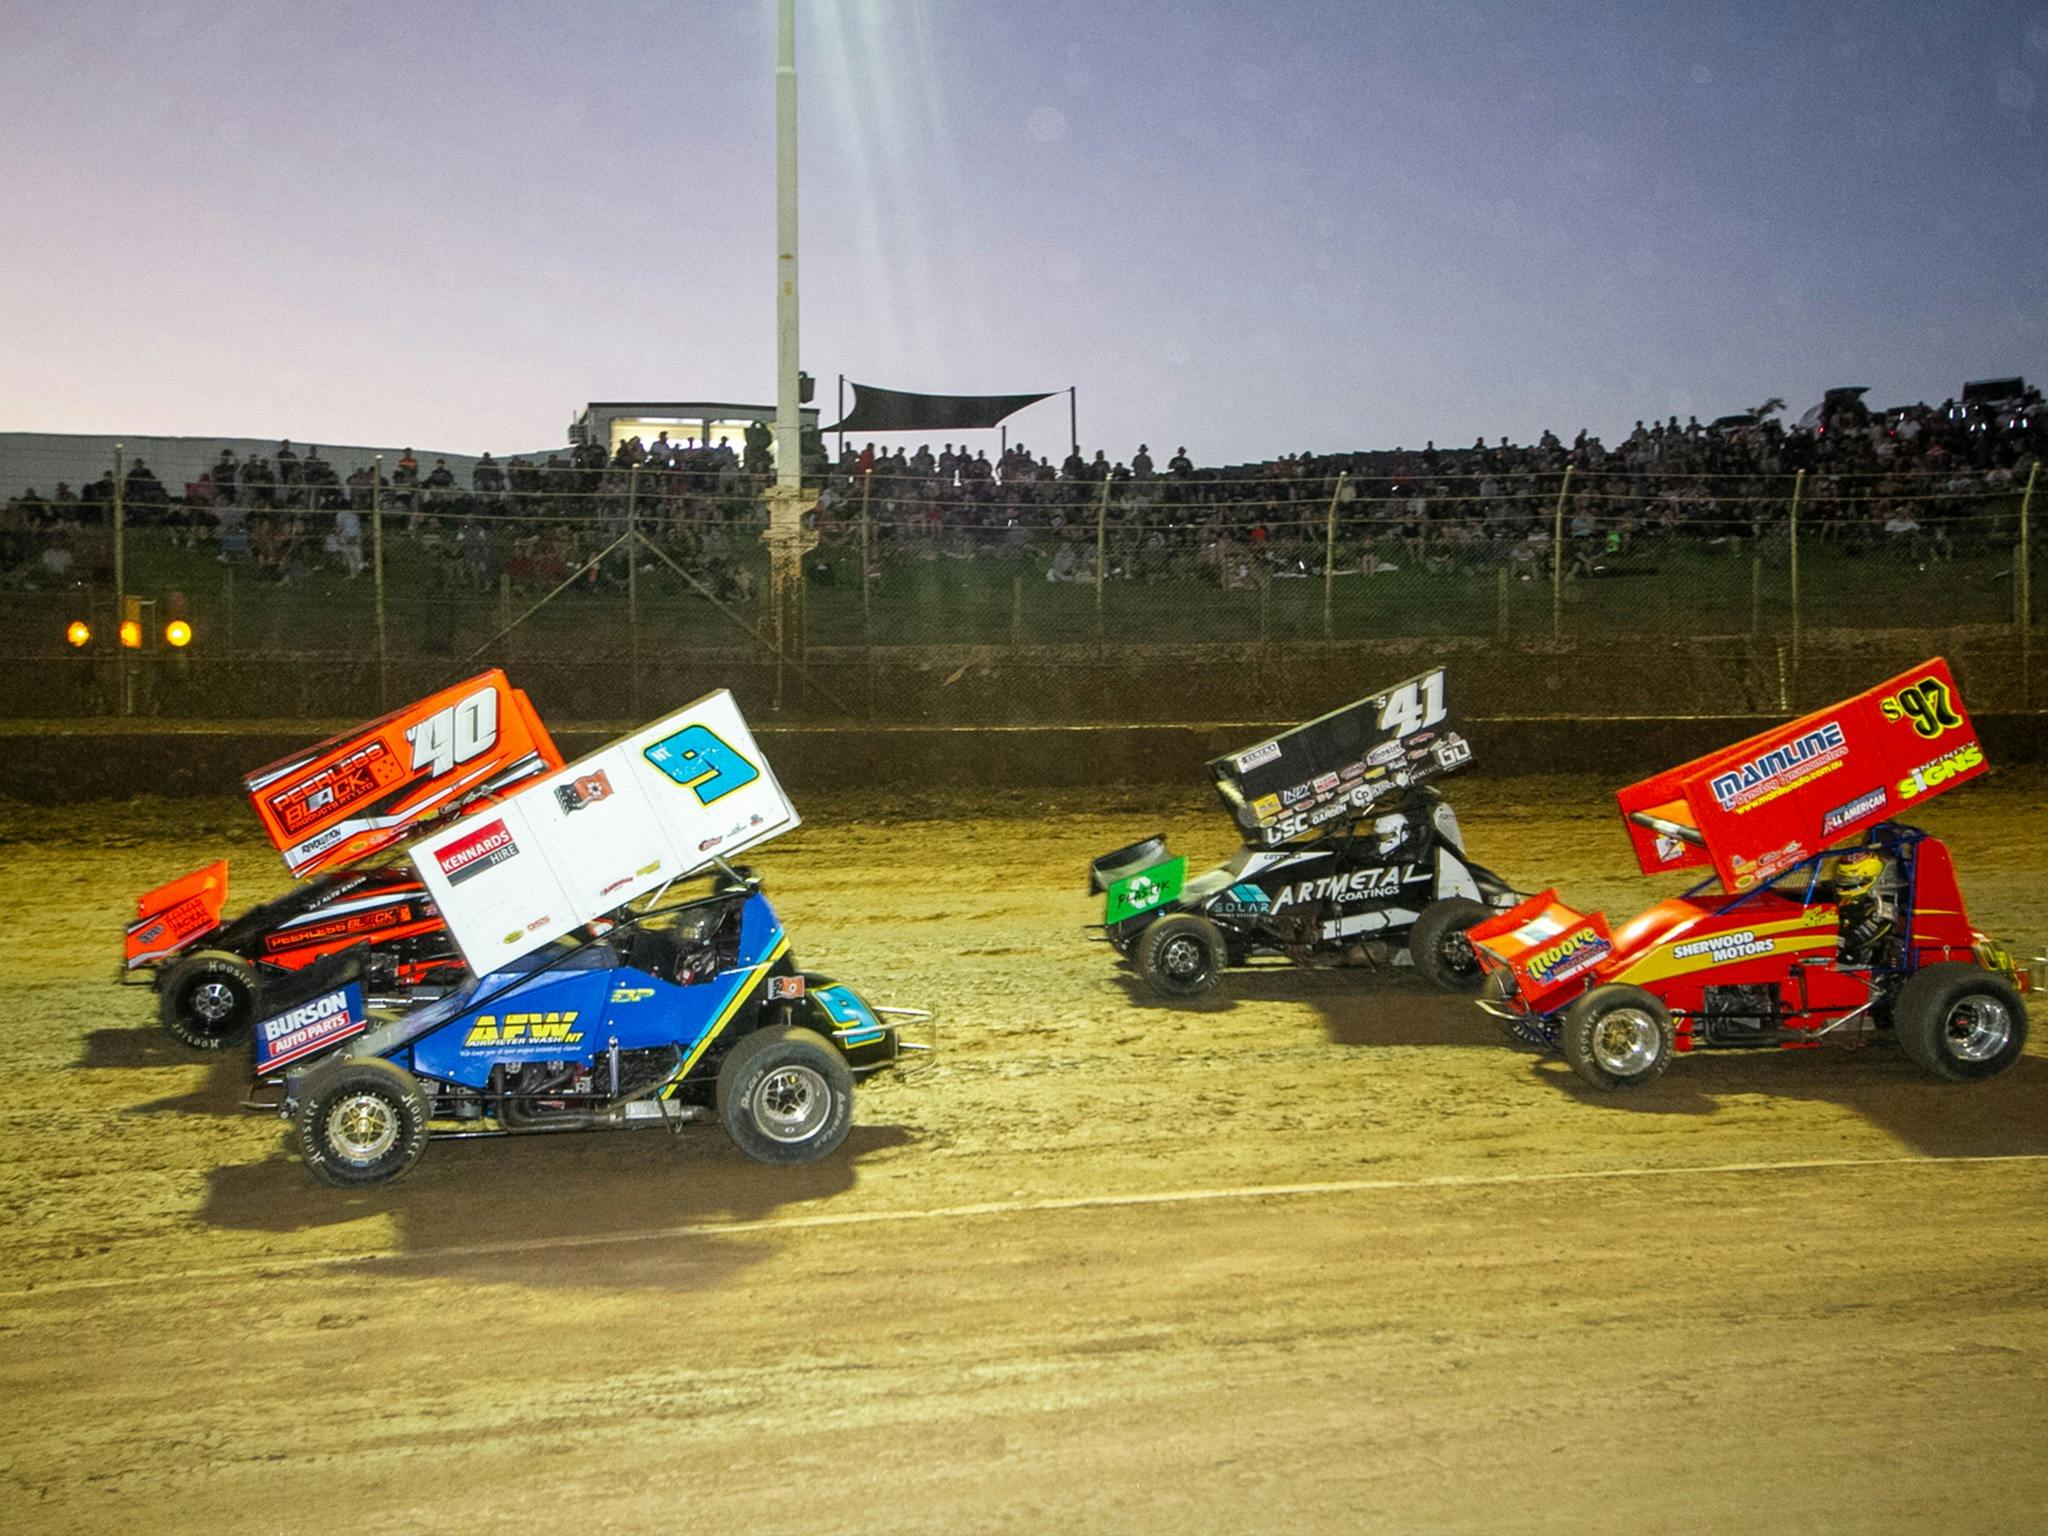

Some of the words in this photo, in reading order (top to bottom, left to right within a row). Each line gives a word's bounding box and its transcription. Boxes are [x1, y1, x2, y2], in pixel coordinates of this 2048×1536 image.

[1711, 721, 1846, 803] MAINLINE
[1843, 792, 1886, 822] AMERICAN
[441, 830, 510, 872] KENNARDS
[489, 844, 517, 865] HIRE
[1214, 902, 1270, 913] SOLAR
[1337, 885, 1400, 903] COATINGS
[1674, 931, 1754, 958] SHERWOOD
[1713, 939, 1774, 962] MOTORS
[263, 990, 347, 1042] BURSON
[465, 1011, 579, 1042] AFW
[275, 1028, 307, 1053] AUTO
[308, 1013, 346, 1039] PARTS
[490, 1037, 526, 1046] FILTER
[528, 1036, 562, 1045] WASH
[564, 1032, 584, 1043] NT
